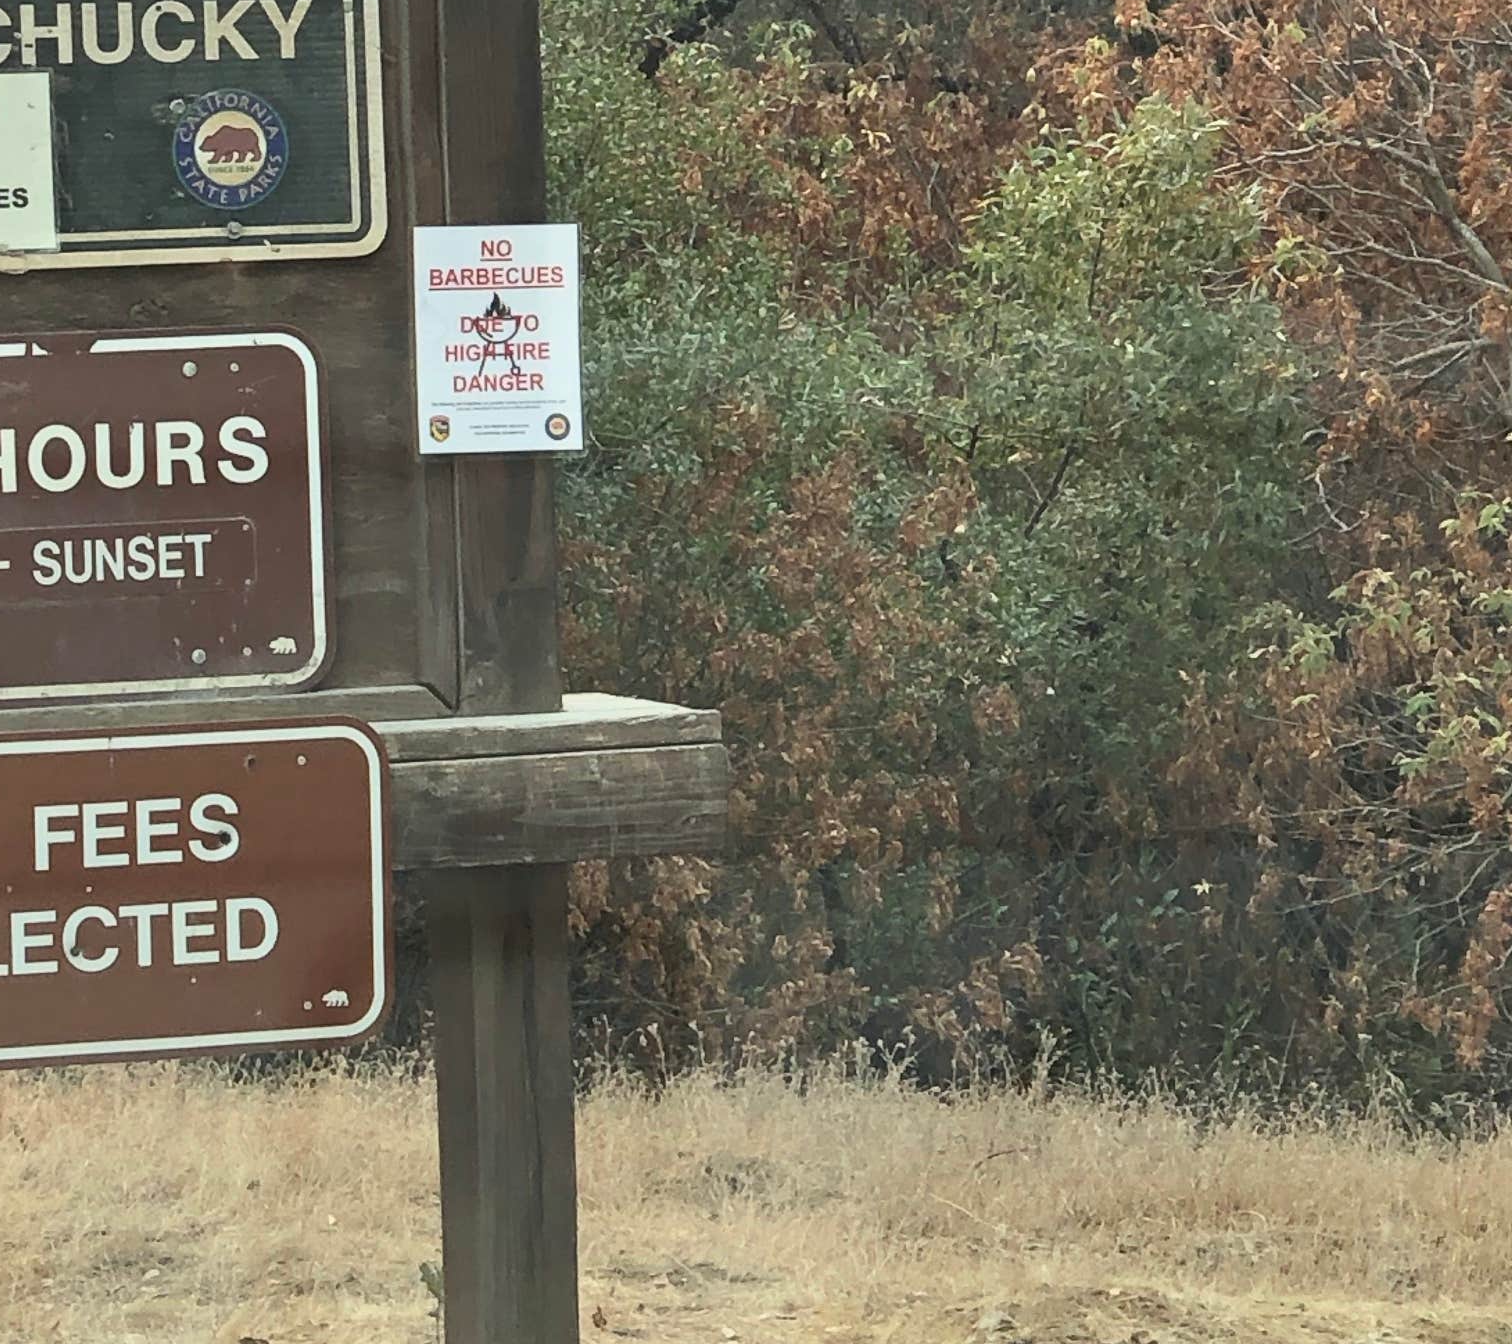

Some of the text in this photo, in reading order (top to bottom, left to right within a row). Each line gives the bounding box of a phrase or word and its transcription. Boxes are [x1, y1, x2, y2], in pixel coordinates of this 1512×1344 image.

[179, 93, 280, 143] CALIFORNIA
[178, 154, 283, 204] STATE PARKS
[480, 239, 513, 258] NO
[428, 266, 564, 287] BARBECUES
[460, 314, 540, 334] DUE TO
[445, 342, 551, 363] HIGH FIRE
[453, 373, 545, 393] DANGER
[32, 533, 213, 586] SUNSET
[33, 793, 241, 872] FEES
